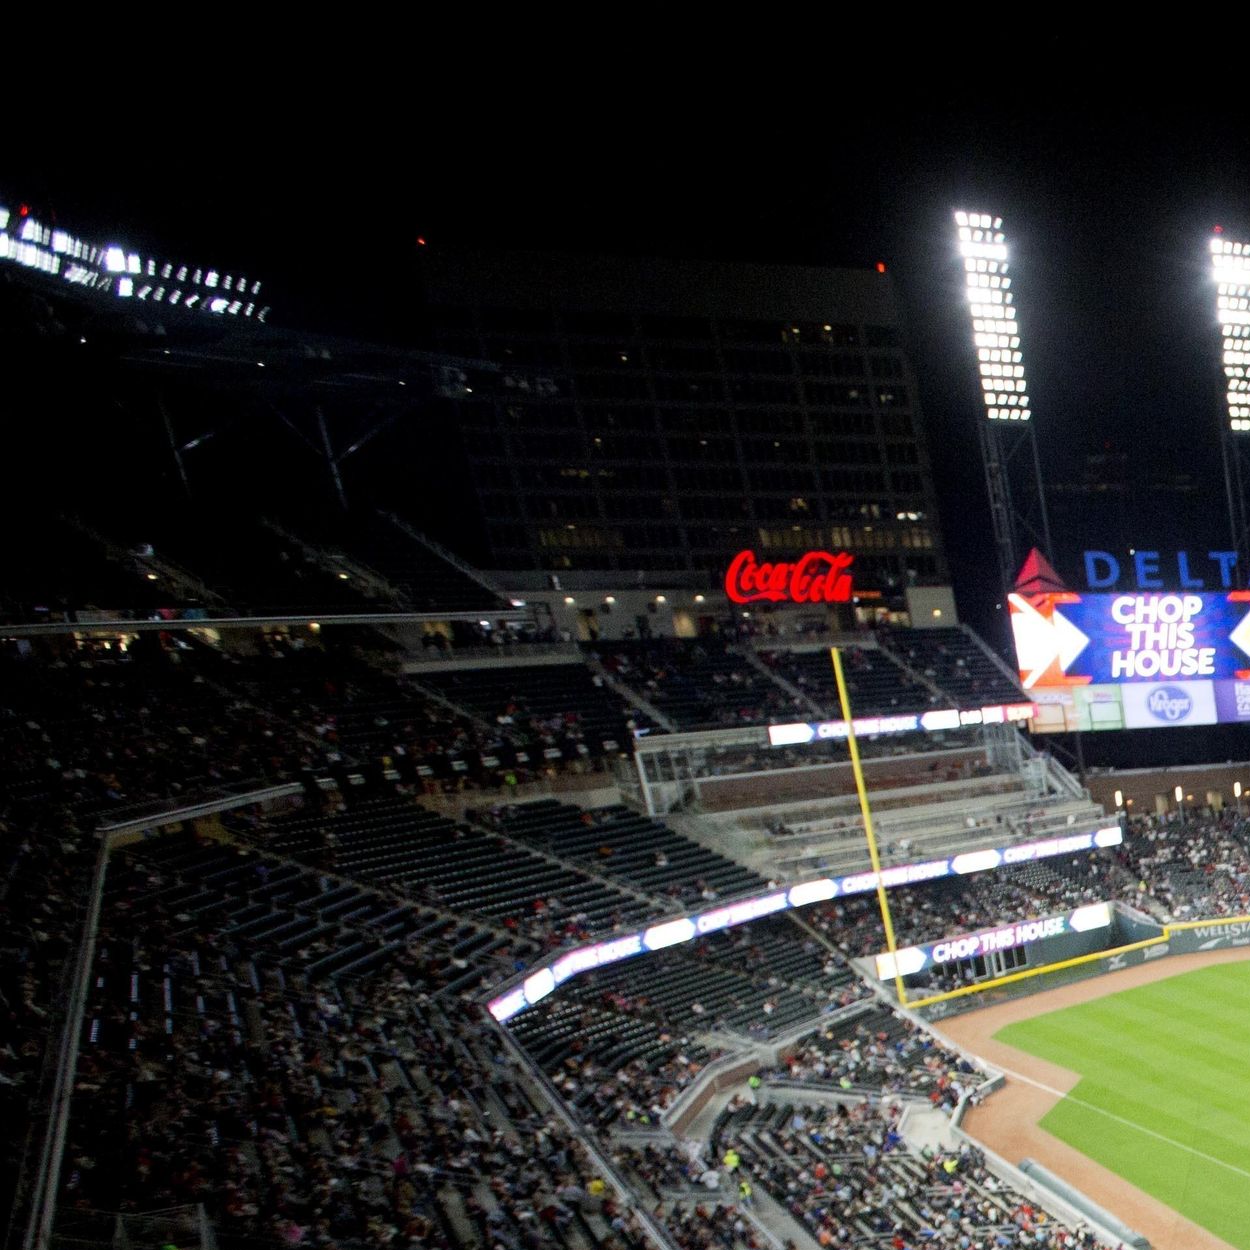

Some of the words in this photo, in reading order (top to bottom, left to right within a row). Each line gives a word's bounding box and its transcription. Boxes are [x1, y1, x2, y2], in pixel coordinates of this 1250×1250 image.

[725, 550, 854, 604] Coca-Cola
[1111, 596, 1203, 624] CHOP
[1125, 623, 1195, 650] THIS
[1111, 648, 1217, 678] HOUSE
[933, 936, 980, 963] CHOP
[980, 928, 1015, 952] THIS
[1015, 916, 1065, 942] HOUSE
